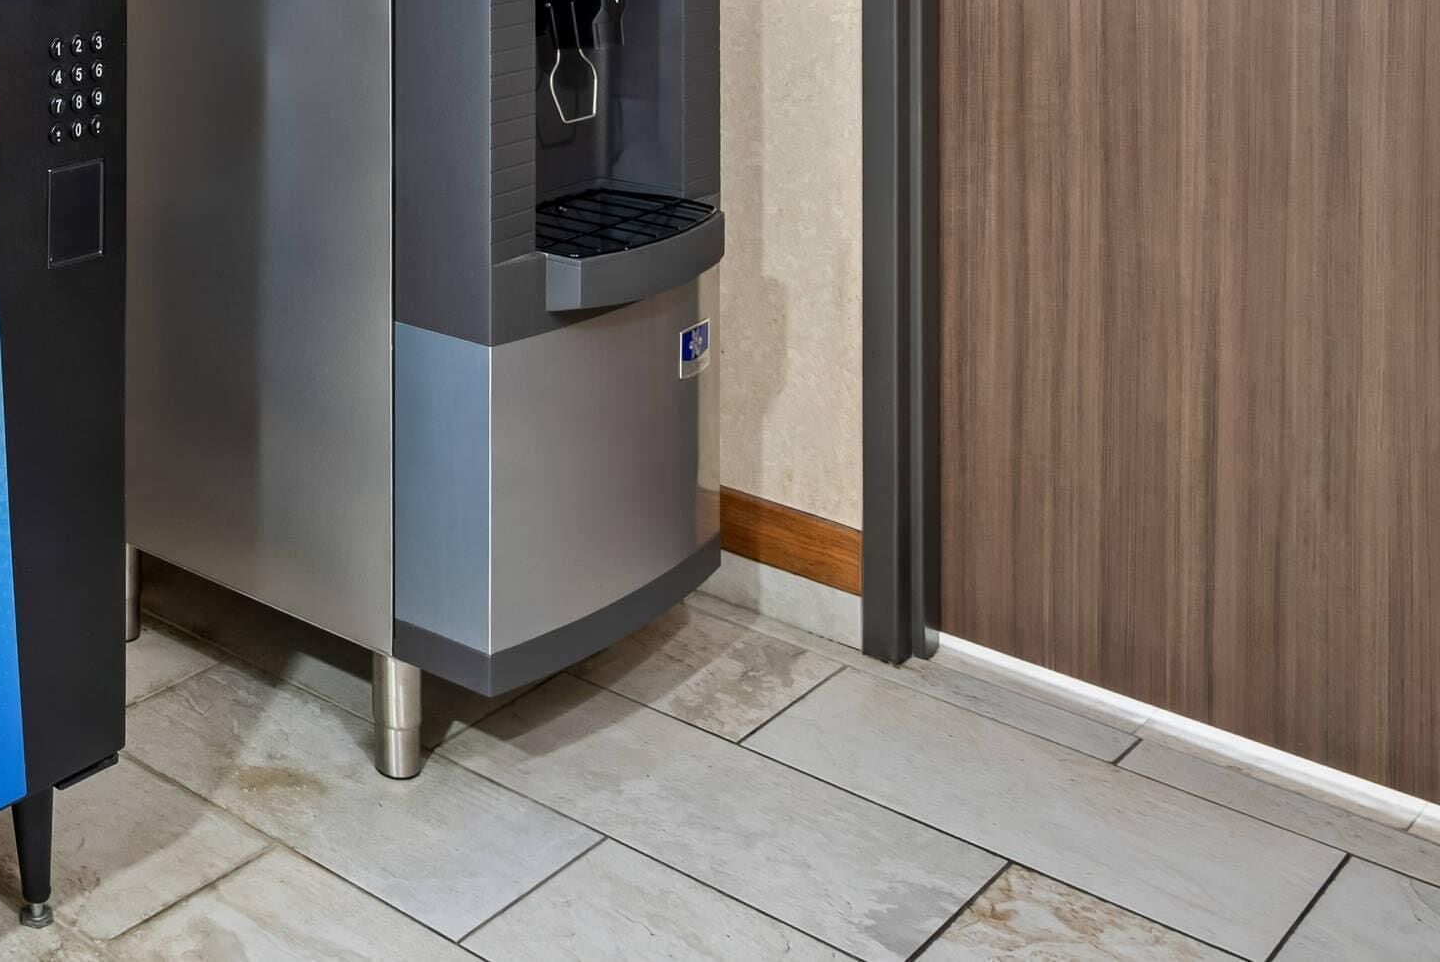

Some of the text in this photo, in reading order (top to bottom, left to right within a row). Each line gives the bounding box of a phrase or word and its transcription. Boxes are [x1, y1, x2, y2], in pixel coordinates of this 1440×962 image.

[55, 35, 103, 56] 1 2 3
[55, 63, 103, 85] 4 5 6
[55, 91, 102, 113] 7 8 9
[75, 122, 82, 137] 0
